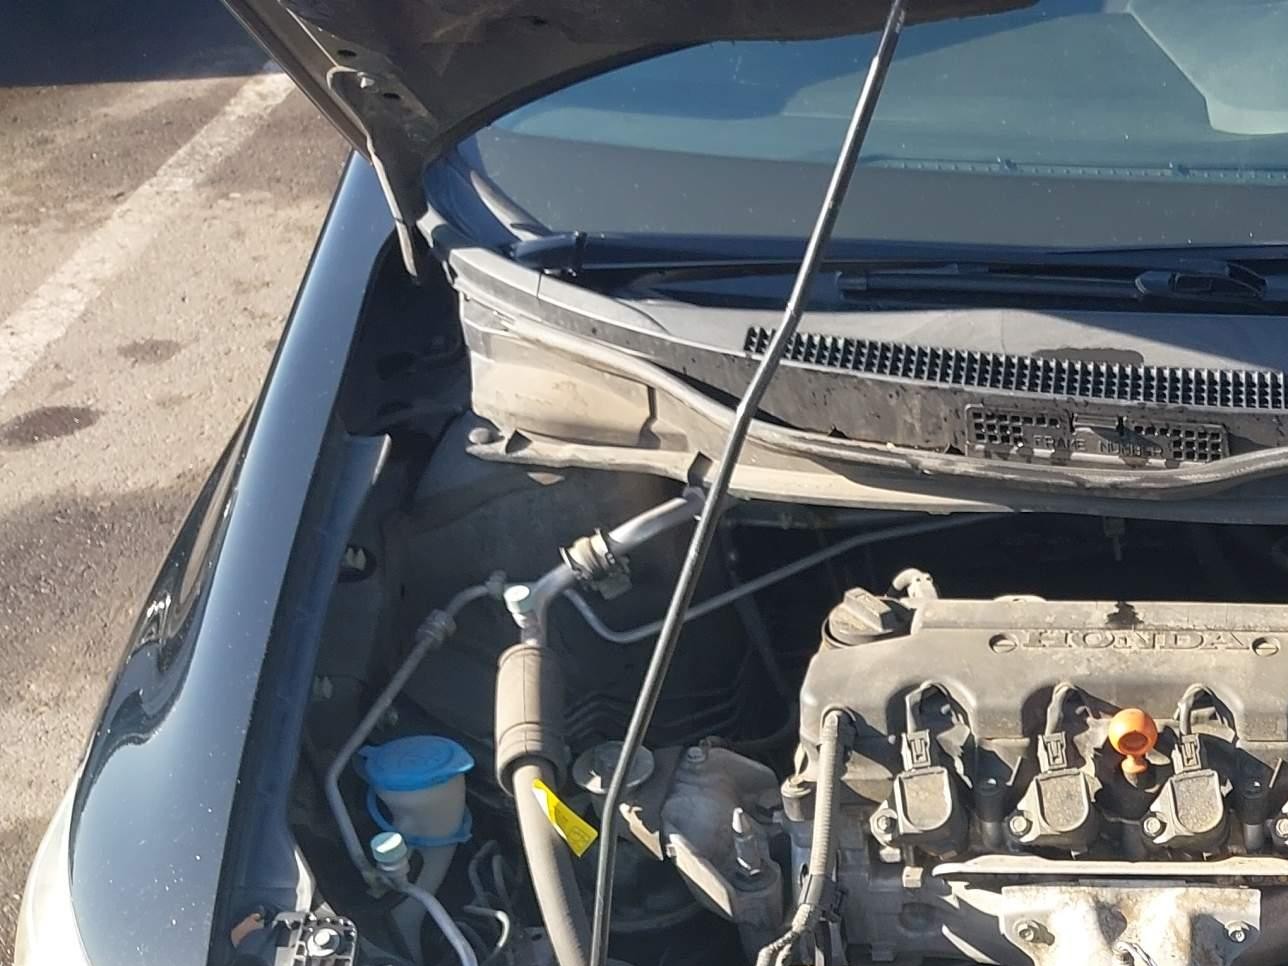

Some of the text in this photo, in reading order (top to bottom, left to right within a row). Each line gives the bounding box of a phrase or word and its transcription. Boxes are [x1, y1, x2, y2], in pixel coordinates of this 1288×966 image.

[1033, 434, 1163, 457] FRAME NUMBER
[1023, 629, 1250, 650] HONDA
